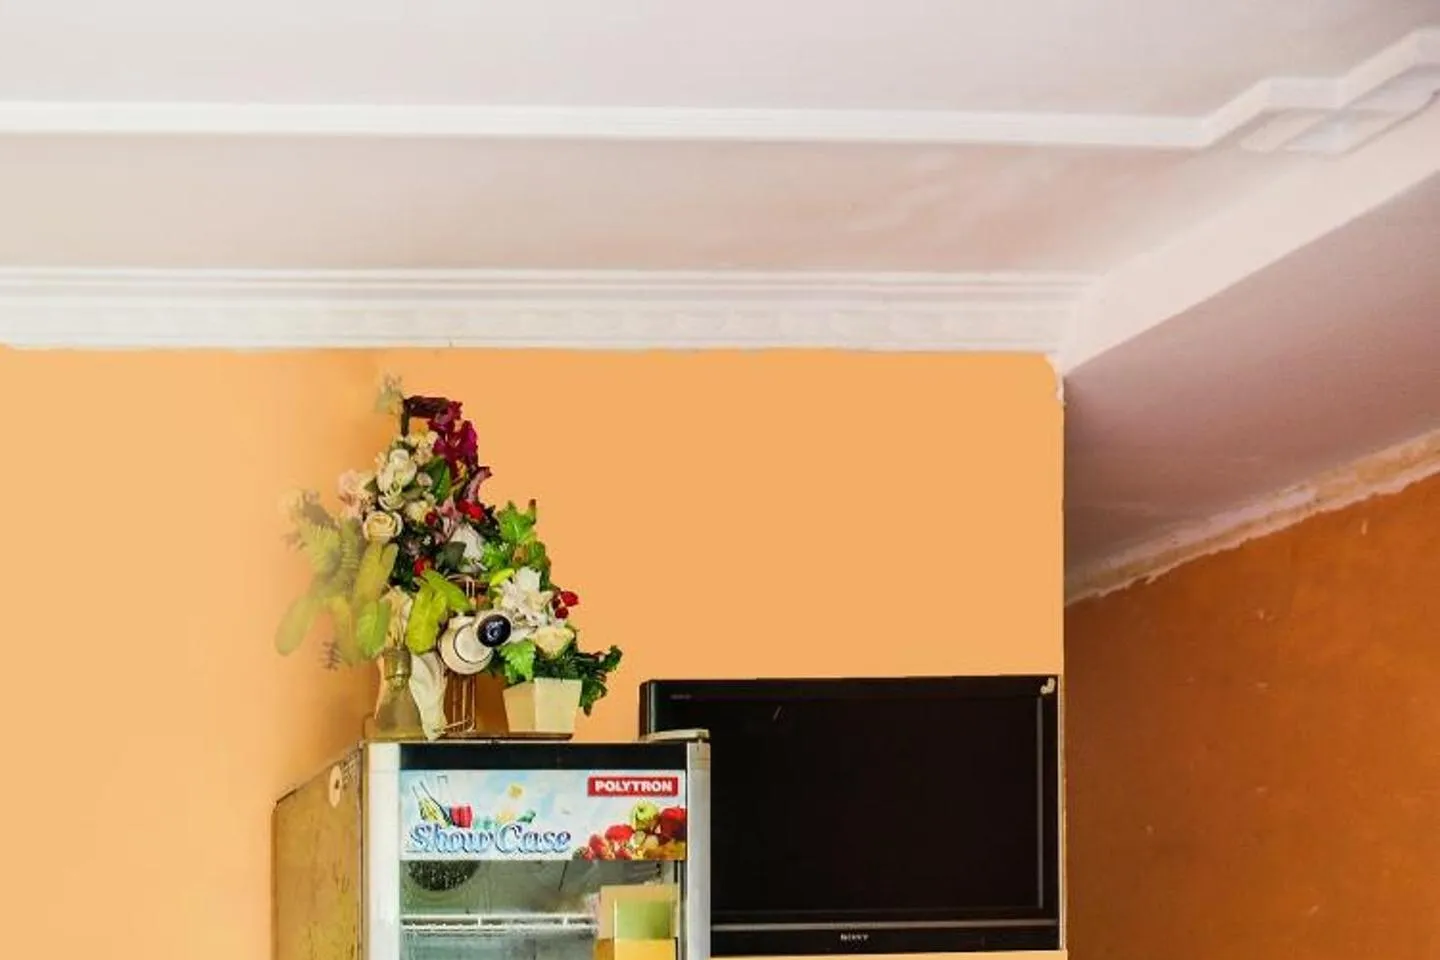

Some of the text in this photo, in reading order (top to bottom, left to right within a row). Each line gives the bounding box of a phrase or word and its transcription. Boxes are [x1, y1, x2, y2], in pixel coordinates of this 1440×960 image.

[594, 780, 673, 793] POLYTRON
[410, 823, 572, 854] Show Case
